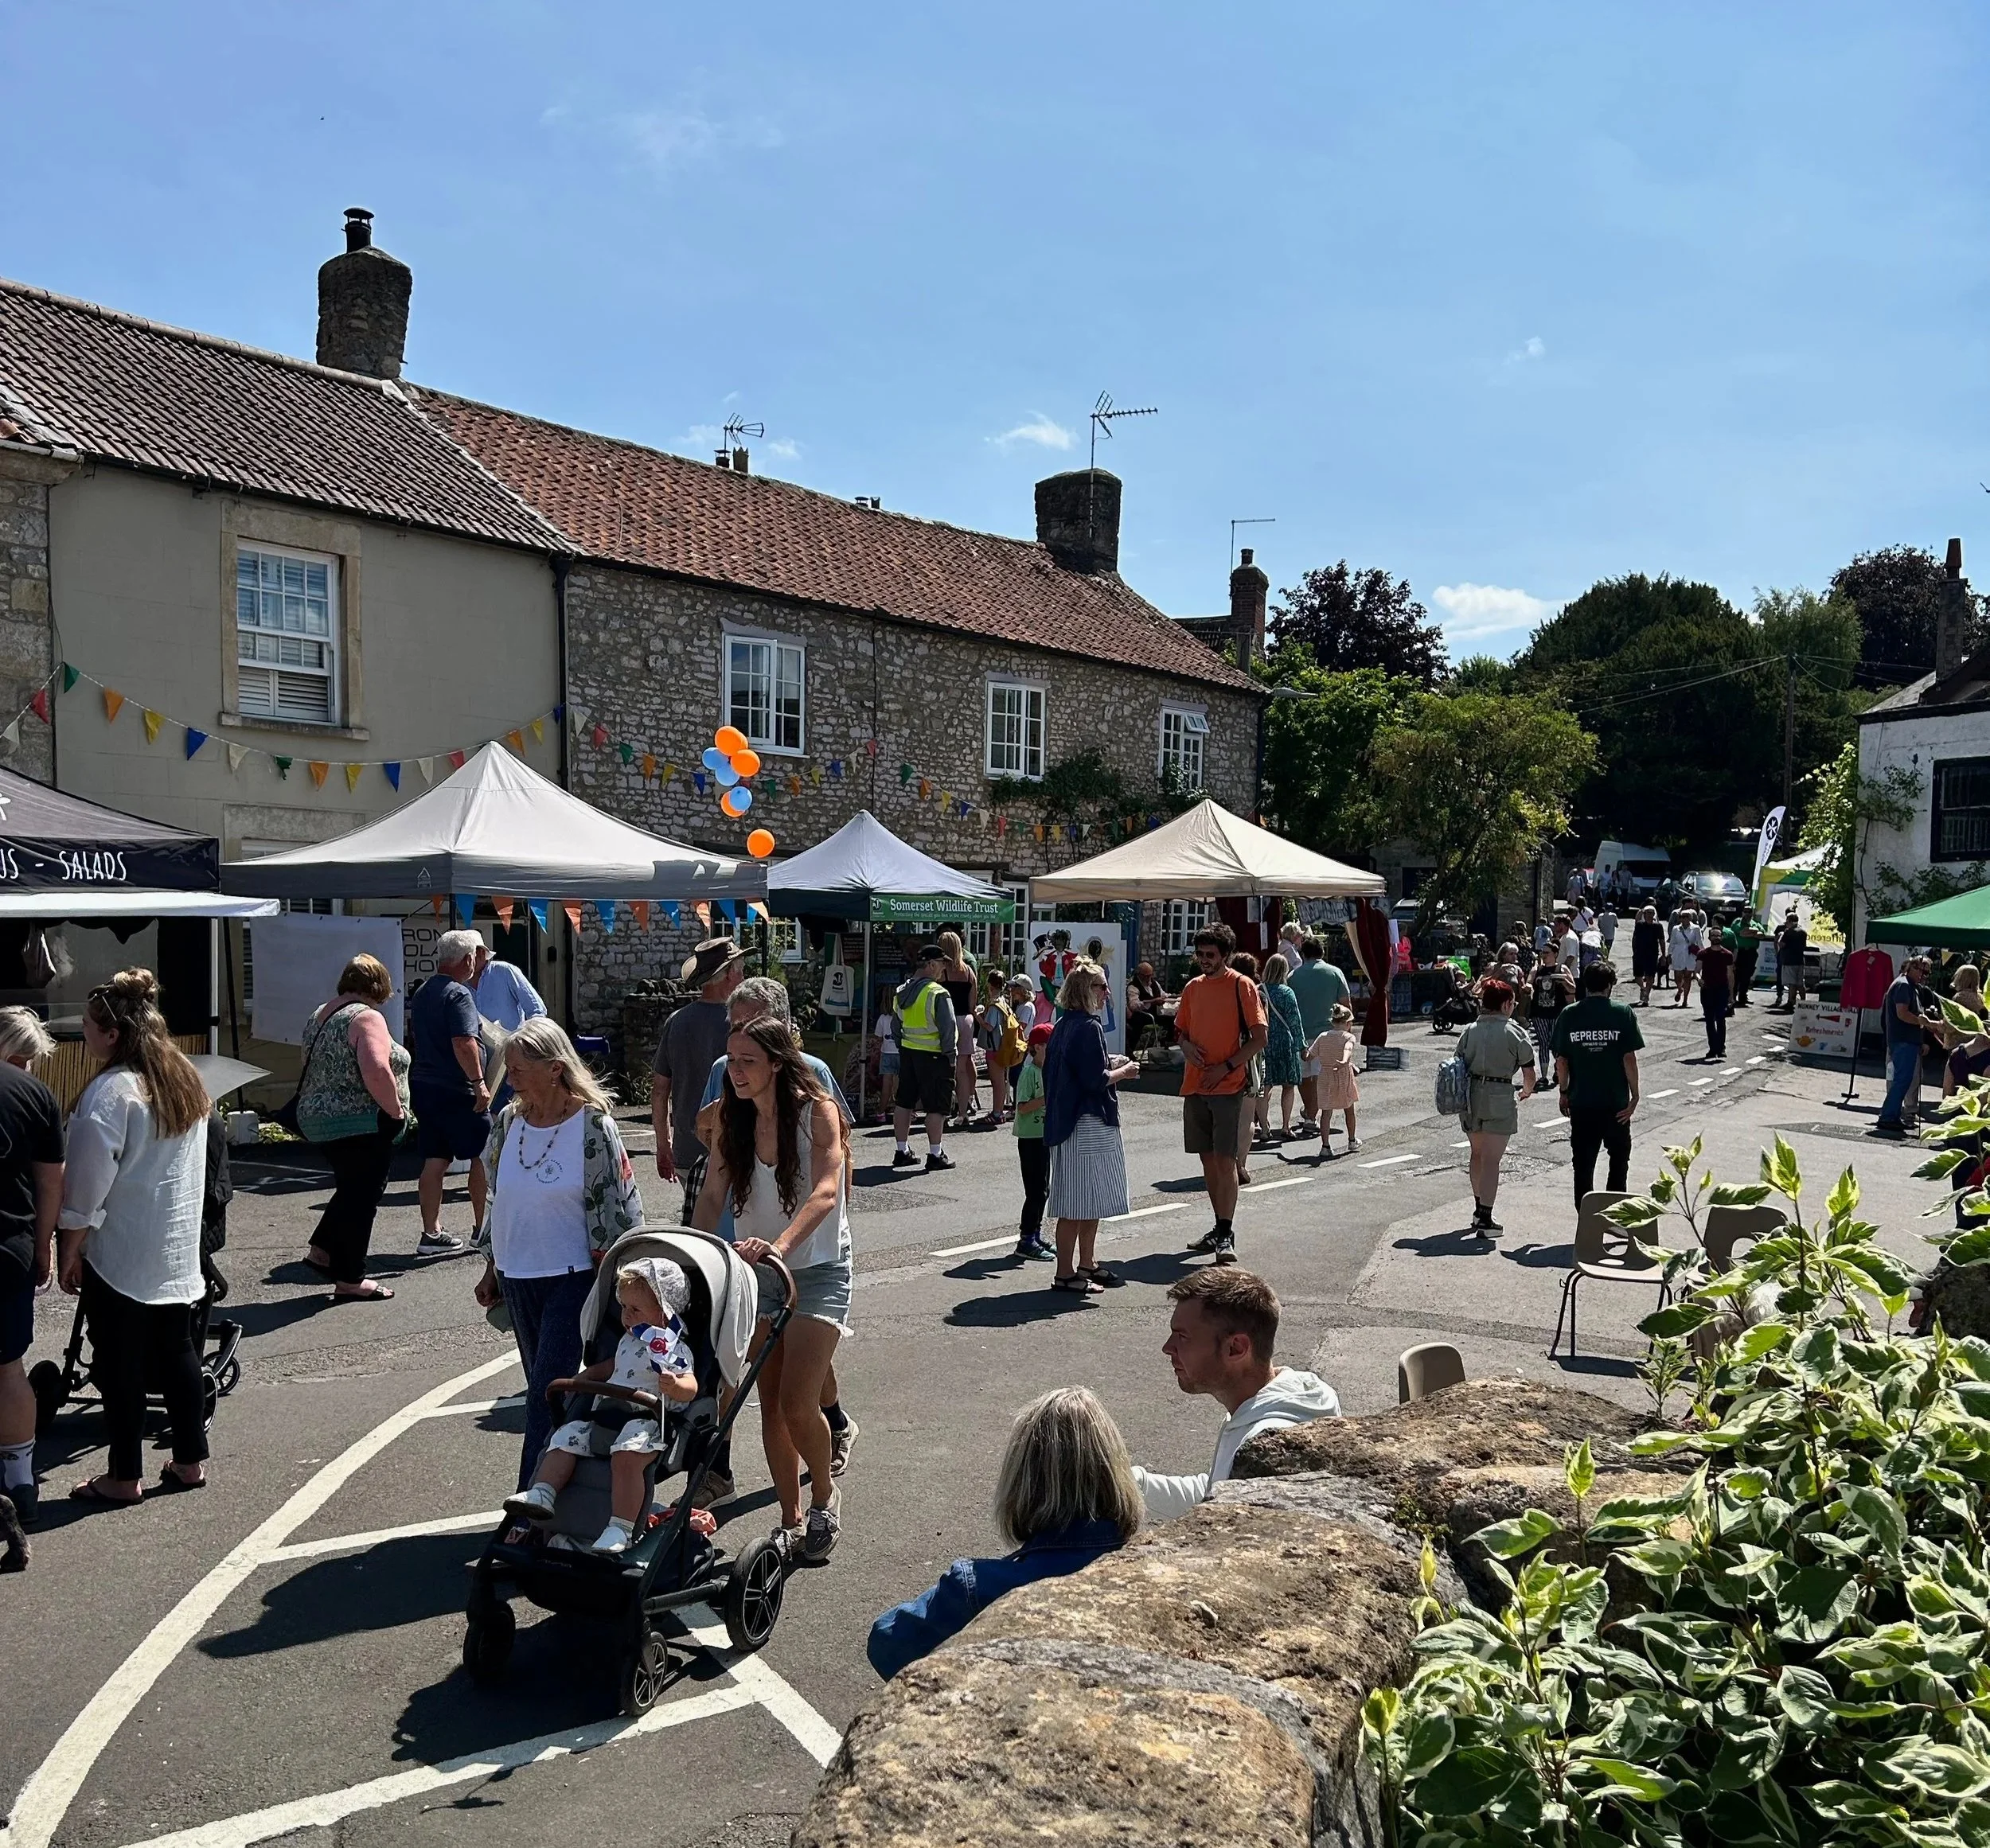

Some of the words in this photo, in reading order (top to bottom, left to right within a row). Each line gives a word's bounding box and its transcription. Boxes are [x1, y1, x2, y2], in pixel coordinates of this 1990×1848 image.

[59, 850, 127, 880] SALADS
[890, 898, 934, 911] Somerset
[935, 899, 973, 913] Wildlife
[974, 901, 998, 914] Trust
[1570, 1030, 1621, 1043] REPRESENT
